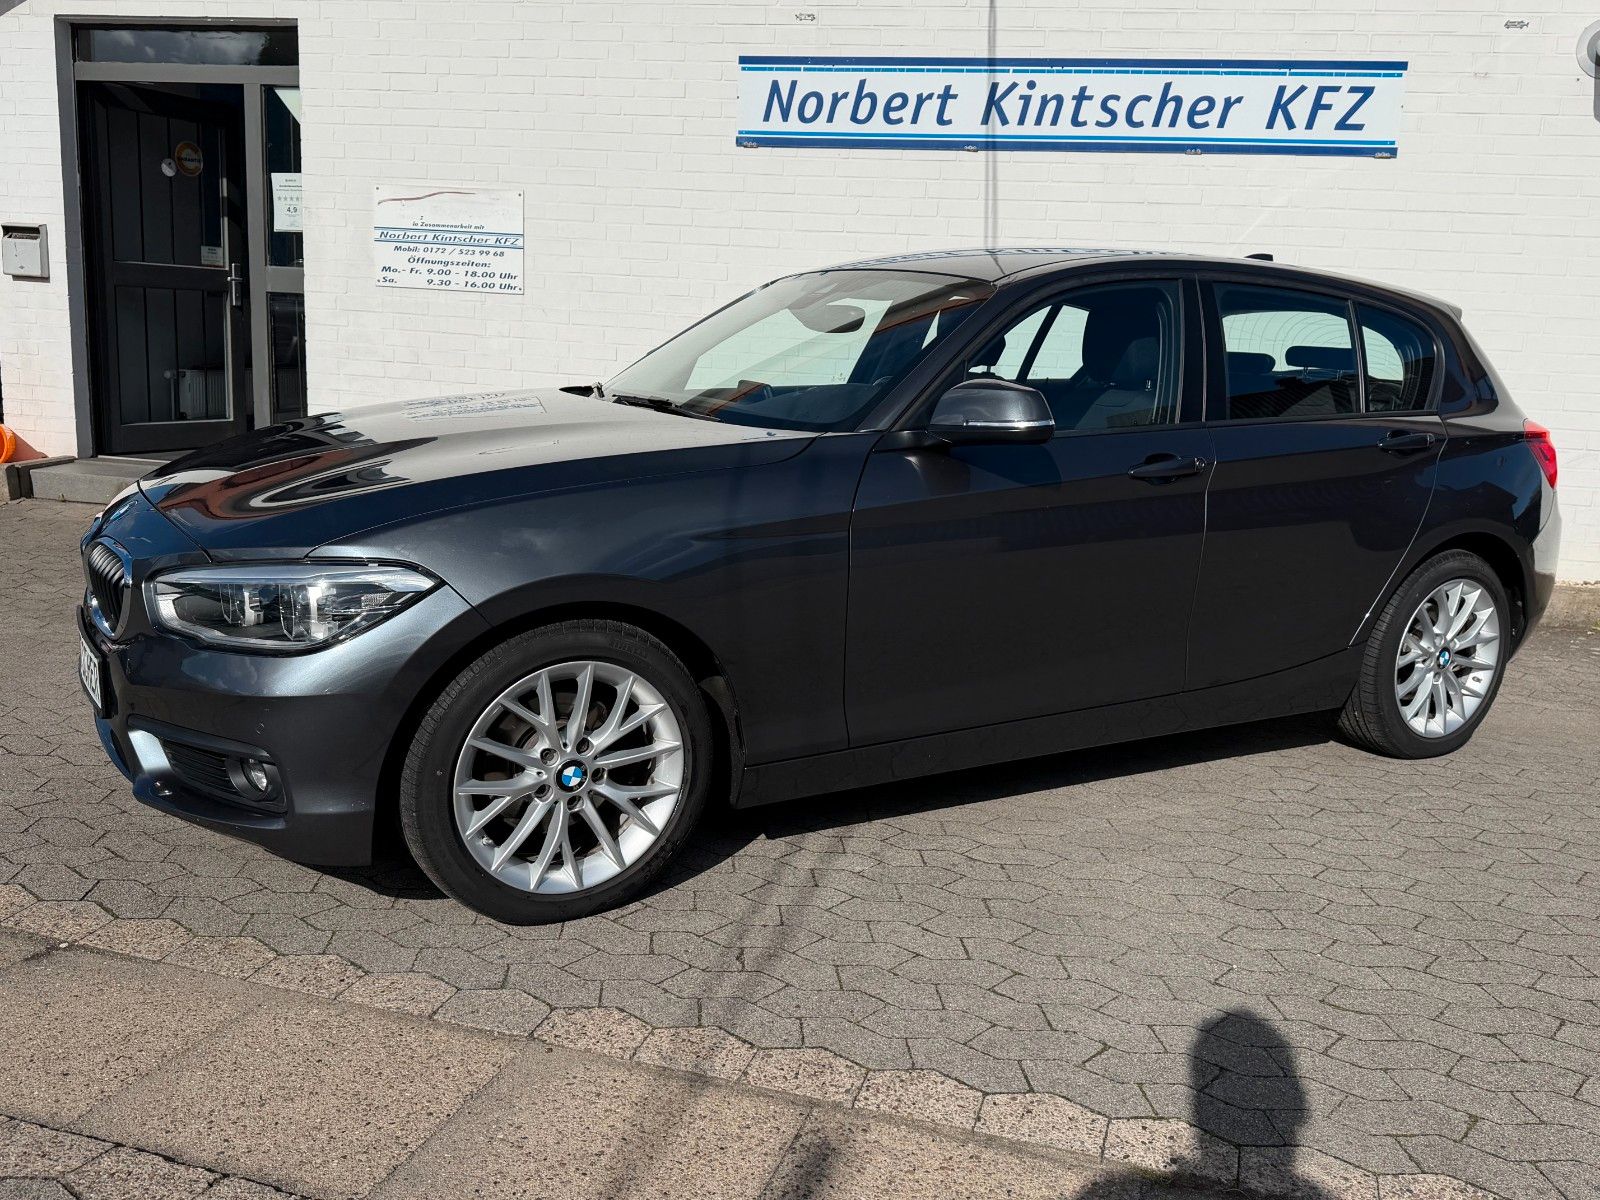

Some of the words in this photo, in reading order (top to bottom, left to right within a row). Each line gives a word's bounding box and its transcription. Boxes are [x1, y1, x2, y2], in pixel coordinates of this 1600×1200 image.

[763, 78, 958, 126] Norbert
[980, 79, 1244, 129] Kintscher
[1265, 84, 1376, 131] KFZ
[379, 231, 428, 241] Norbert
[432, 233, 490, 244] Kintscher
[495, 237, 519, 246] KFZ
[393, 245, 420, 253] Mobil:
[423, 246, 447, 254] 0172
[458, 248, 476, 256] 523
[407, 255, 492, 268] Öffnungszeiten:
[409, 267, 422, 275] Fr.
[427, 268, 452, 276] 9.00
[465, 270, 496, 279] 18.00
[499, 272, 518, 280] Uhr
[382, 276, 398, 284] Sa.
[427, 279, 452, 287] 9.30
[465, 281, 496, 289] 16.00
